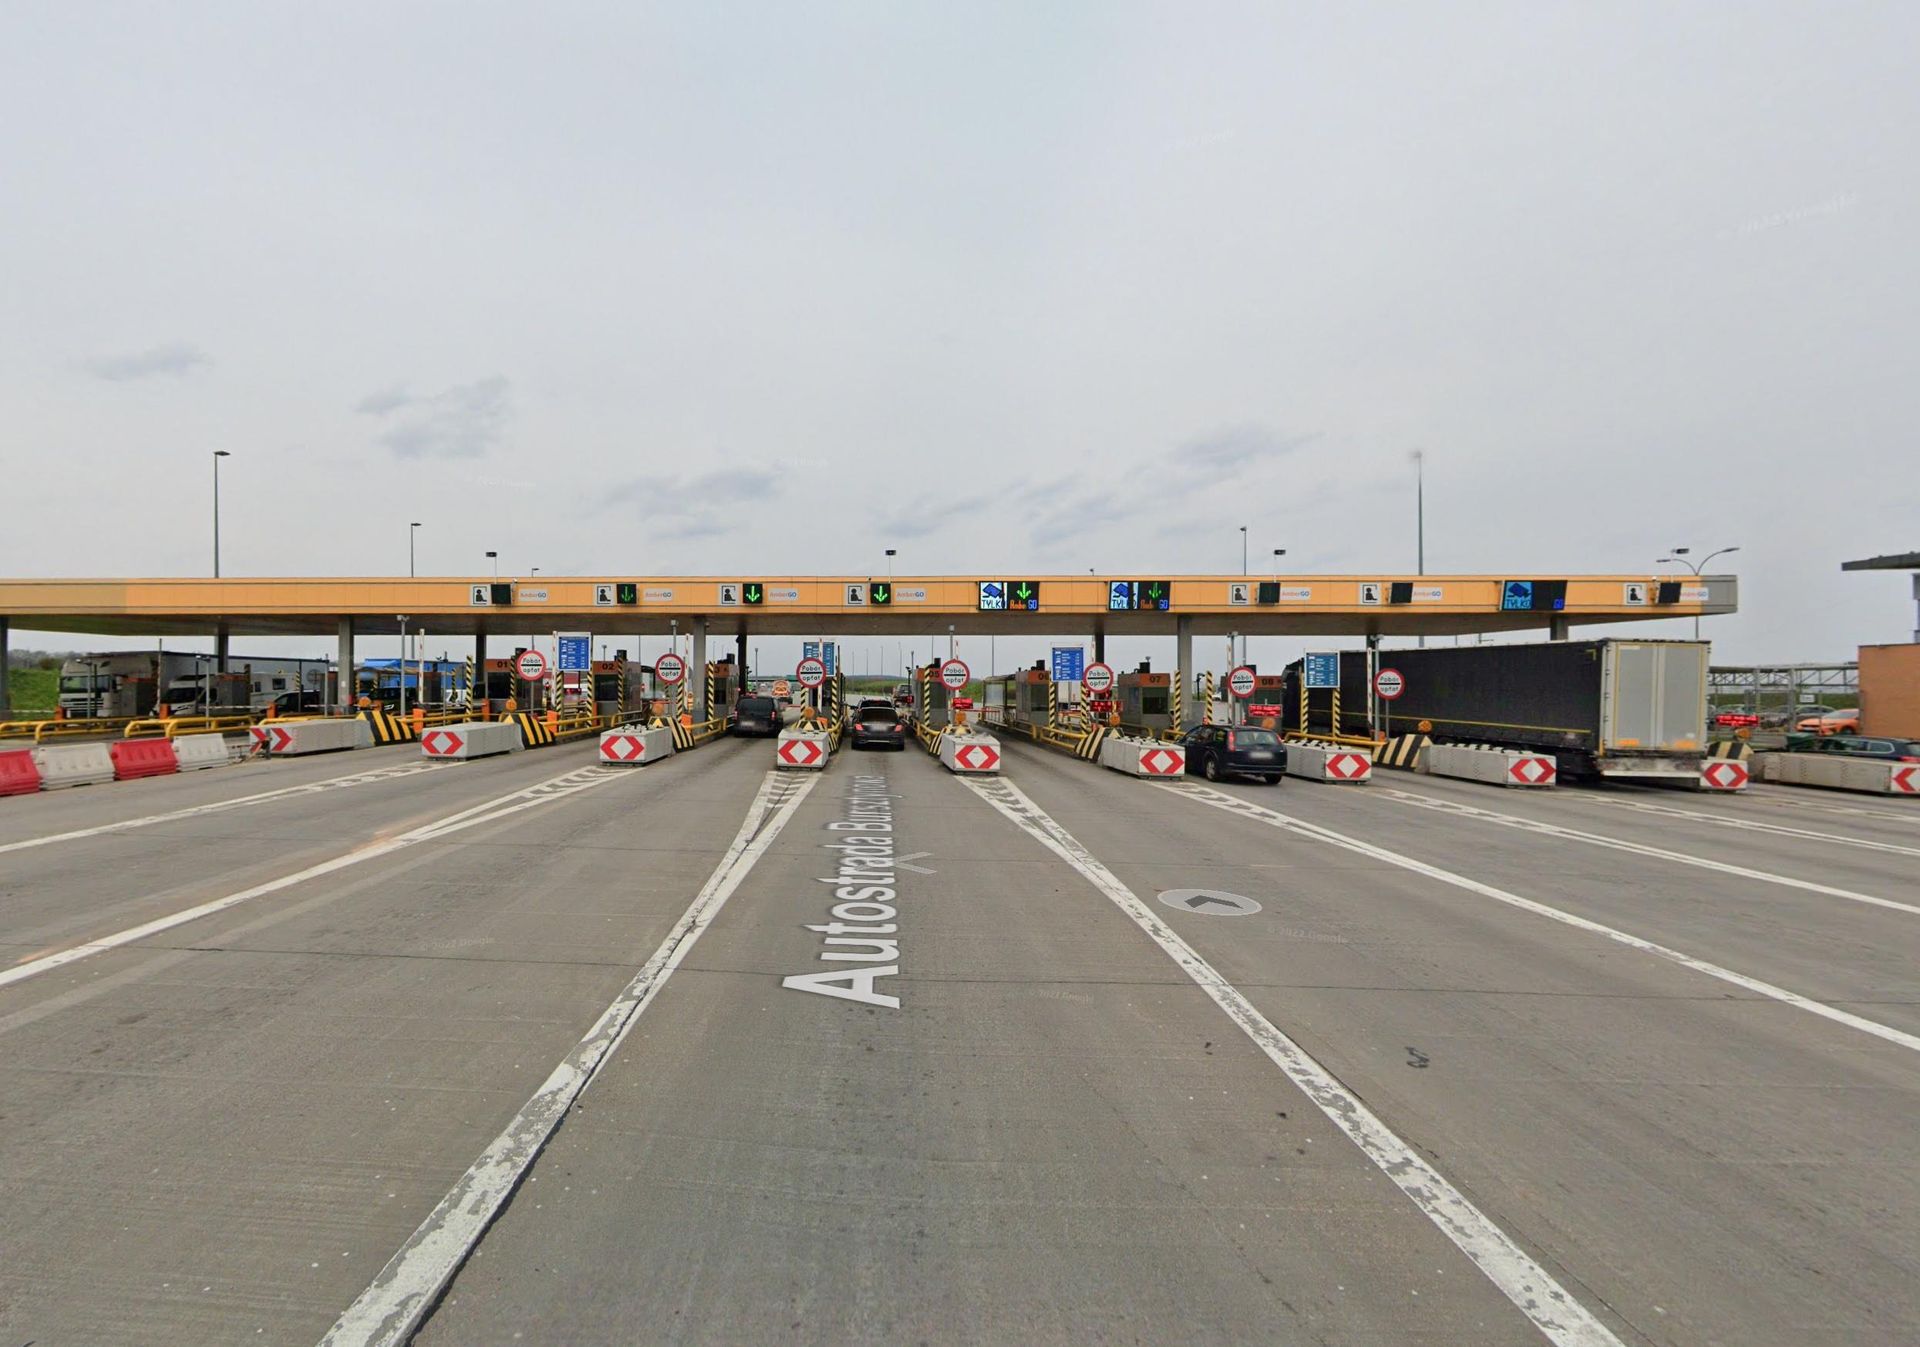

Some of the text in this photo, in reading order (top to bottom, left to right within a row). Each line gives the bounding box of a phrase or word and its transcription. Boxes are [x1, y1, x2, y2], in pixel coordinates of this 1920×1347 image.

[1112, 600, 1136, 609] TYLO
[802, 674, 820, 683] opłat
[945, 676, 964, 684] opłat
[1089, 680, 1108, 688] opłat
